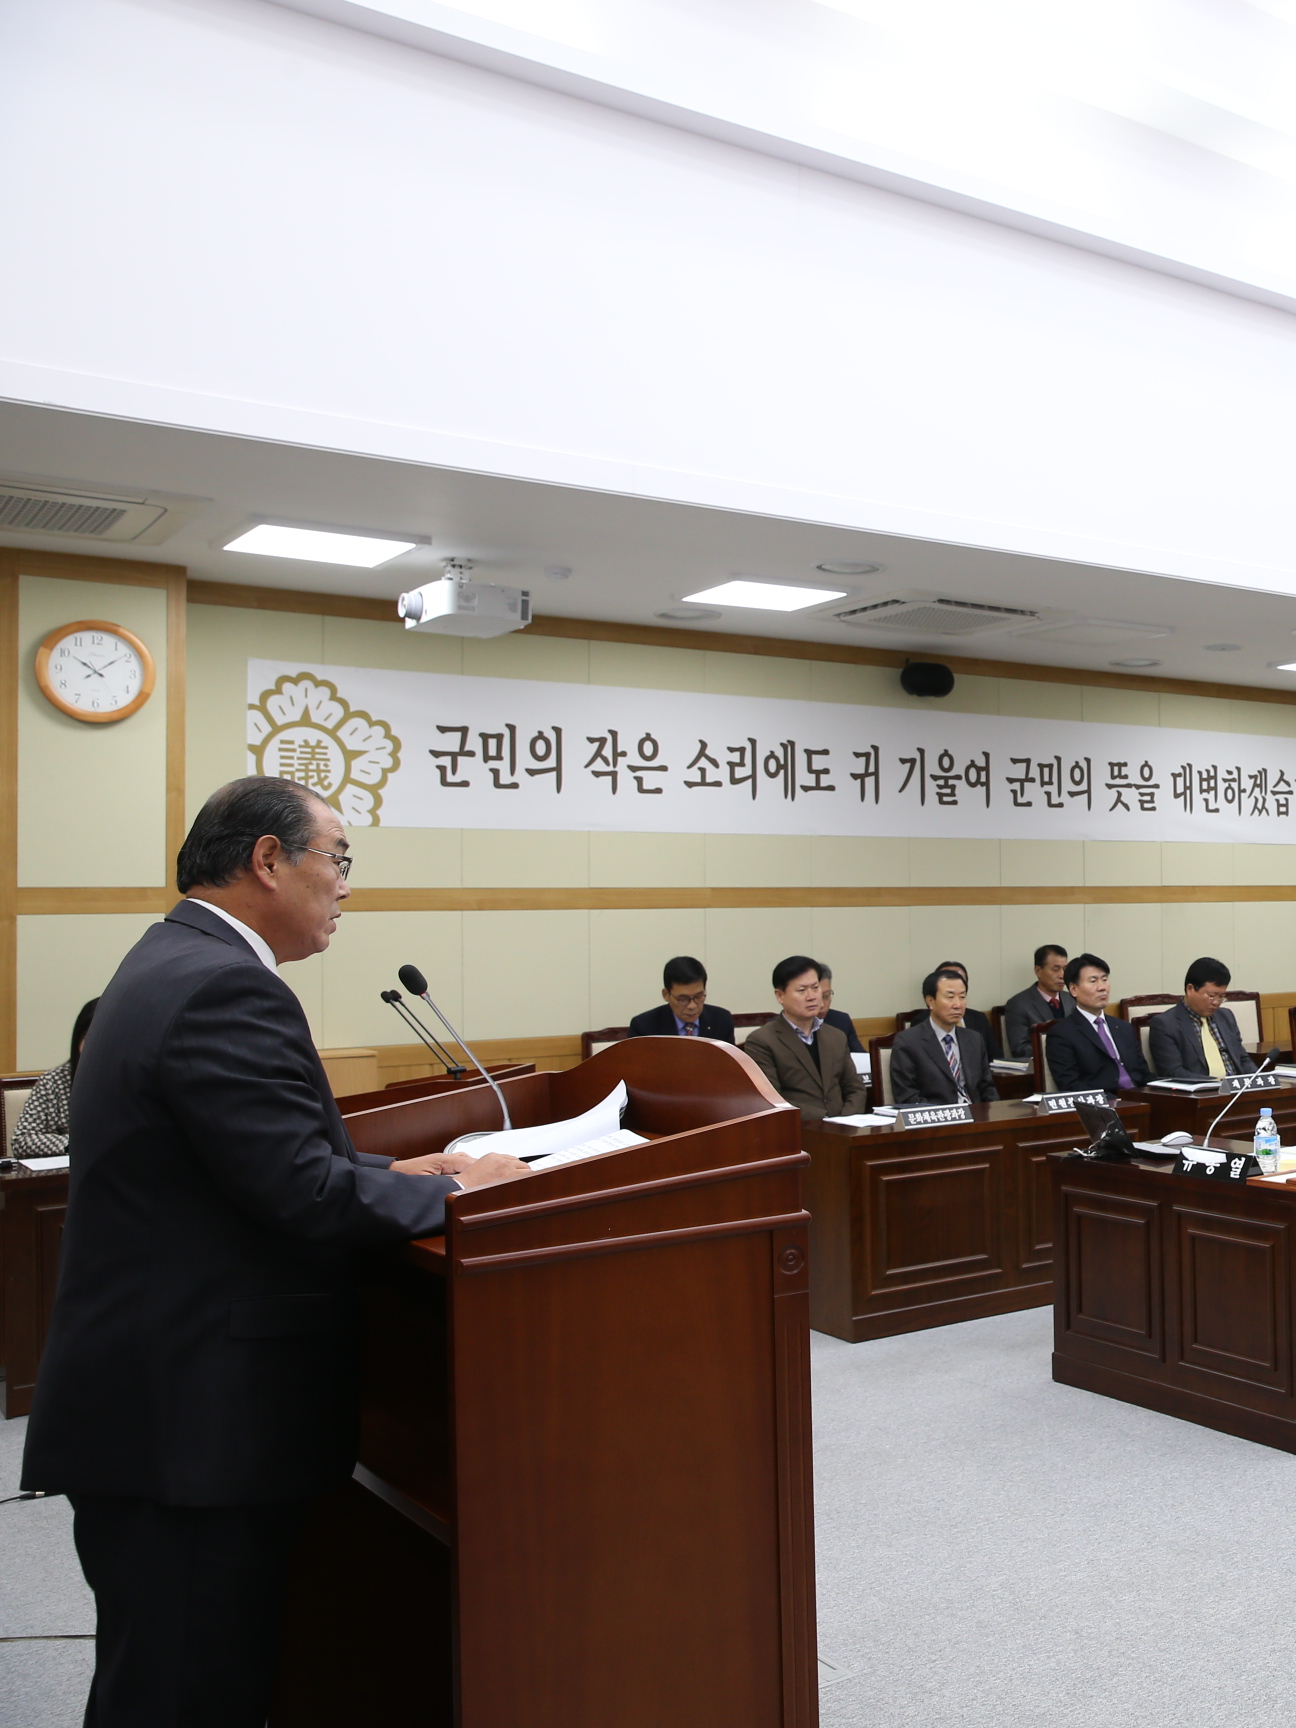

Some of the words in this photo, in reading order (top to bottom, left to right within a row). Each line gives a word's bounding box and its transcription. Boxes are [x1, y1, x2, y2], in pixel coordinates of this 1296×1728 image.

[74, 636, 82, 647] 11
[92, 635, 103, 645] 12
[60, 648, 70, 657] 10
[55, 664, 62, 674] 9
[60, 680, 67, 689] 8
[75, 693, 81, 703] 7
[92, 699, 99, 708] 6
[428, 723, 563, 794] 군민의
[584, 729, 669, 795] 작은
[683, 737, 836, 802] 소리에도
[850, 744, 880, 805] 귀
[898, 746, 991, 809] 기울여
[1005, 754, 1092, 812] 군민의
[1104, 760, 1161, 812] 뜻을
[908, 1107, 966, 1124] 문화체육관광과장
